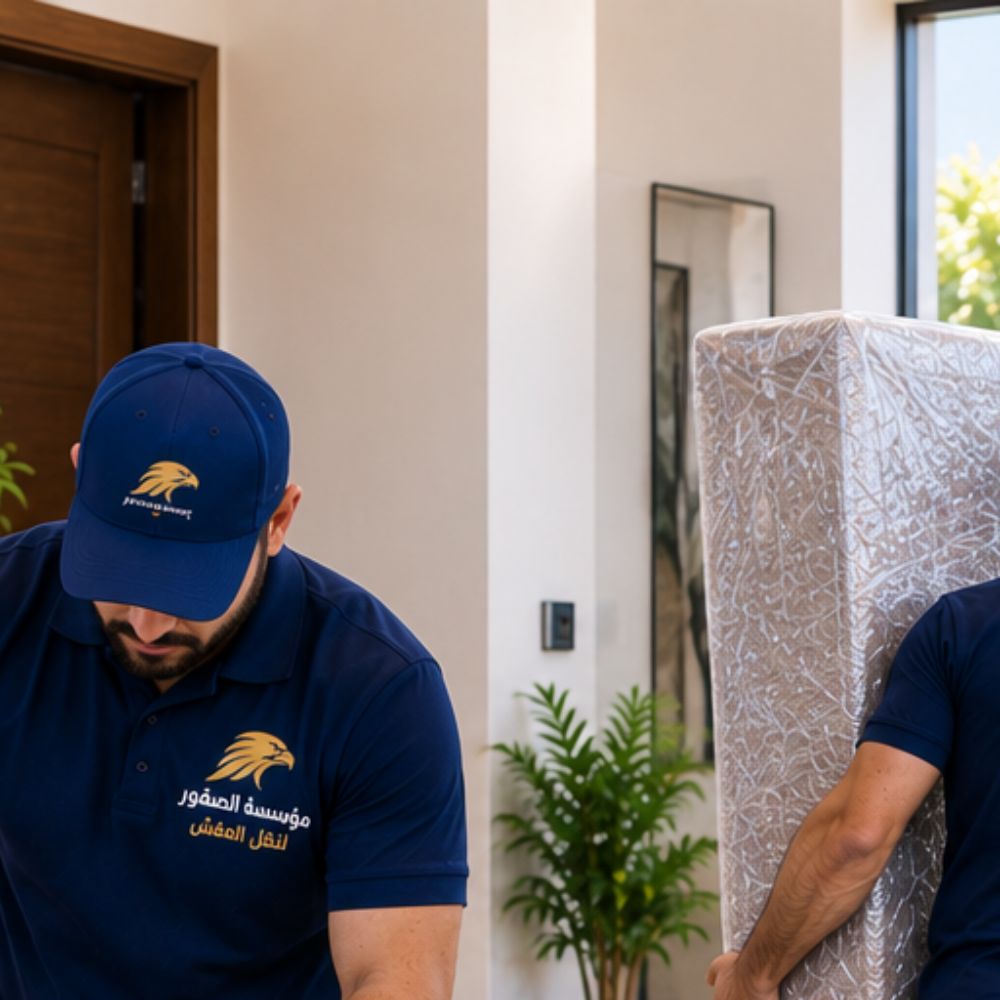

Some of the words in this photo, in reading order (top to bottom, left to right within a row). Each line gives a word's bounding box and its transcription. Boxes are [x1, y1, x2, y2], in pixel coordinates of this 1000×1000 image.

[177, 787, 241, 813] الصقور
[243, 796, 311, 831] مؤسسة
[189, 816, 246, 843] العفش
[249, 829, 289, 851] لنقل
